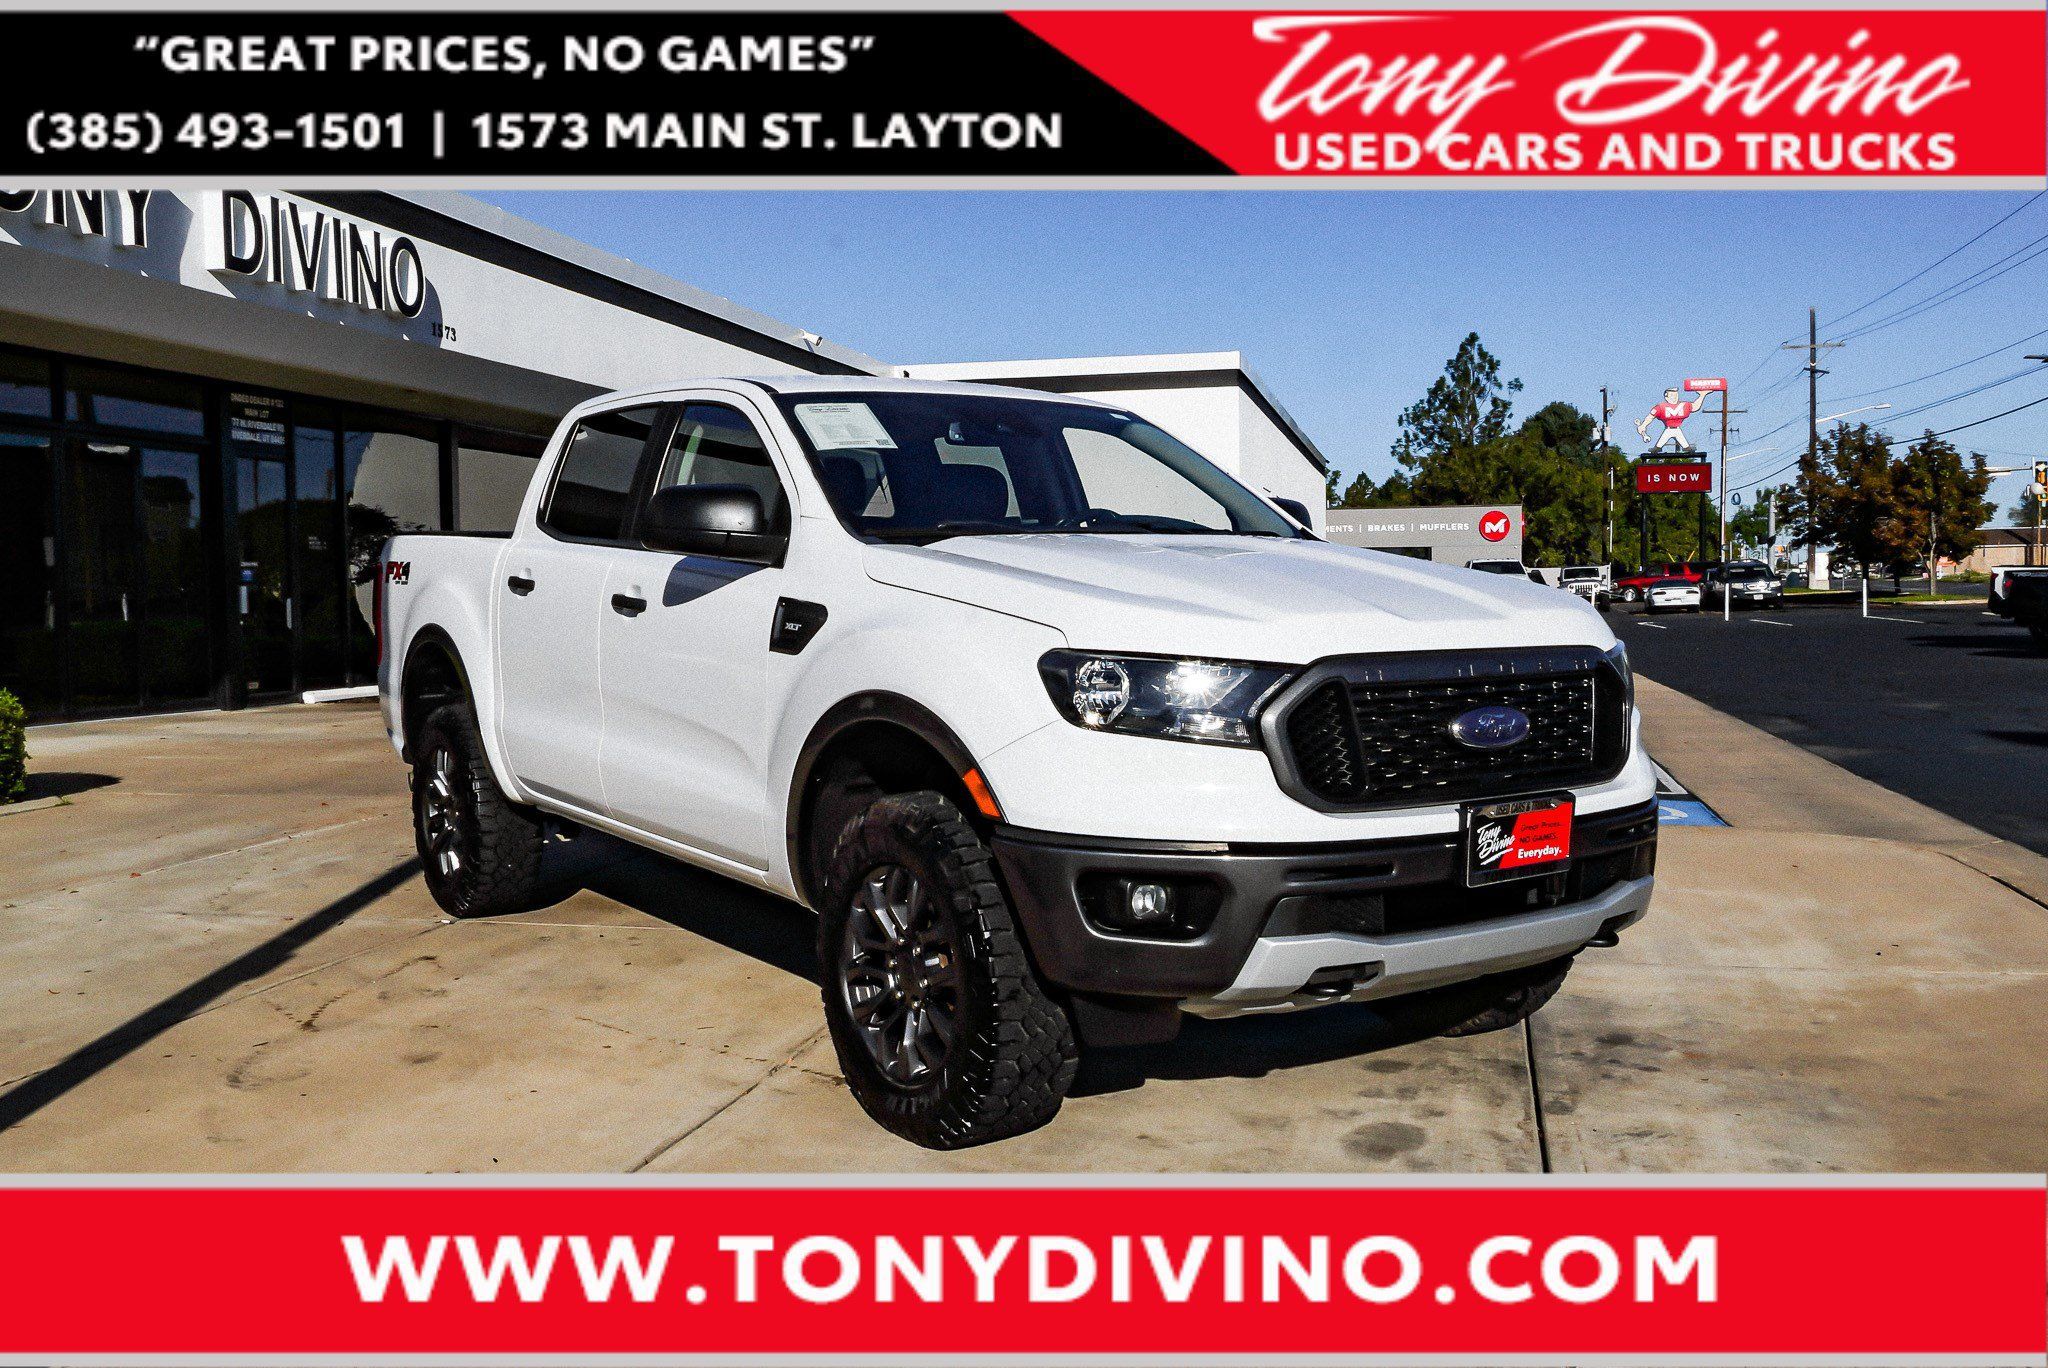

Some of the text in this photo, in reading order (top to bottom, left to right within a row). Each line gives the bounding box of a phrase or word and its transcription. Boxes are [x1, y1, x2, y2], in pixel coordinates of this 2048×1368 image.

[222, 190, 426, 318] DIVINO
[431, 322, 457, 342] 1573
[1647, 473, 1700, 483] IS NOW
[1367, 524, 1406, 532] BRAKES
[1419, 523, 1470, 532] MUFFLERS
[785, 622, 802, 631] XLT
[1477, 822, 1502, 844] Tony
[1477, 834, 1515, 859] Divino
[1517, 845, 1562, 859] Everyday.
